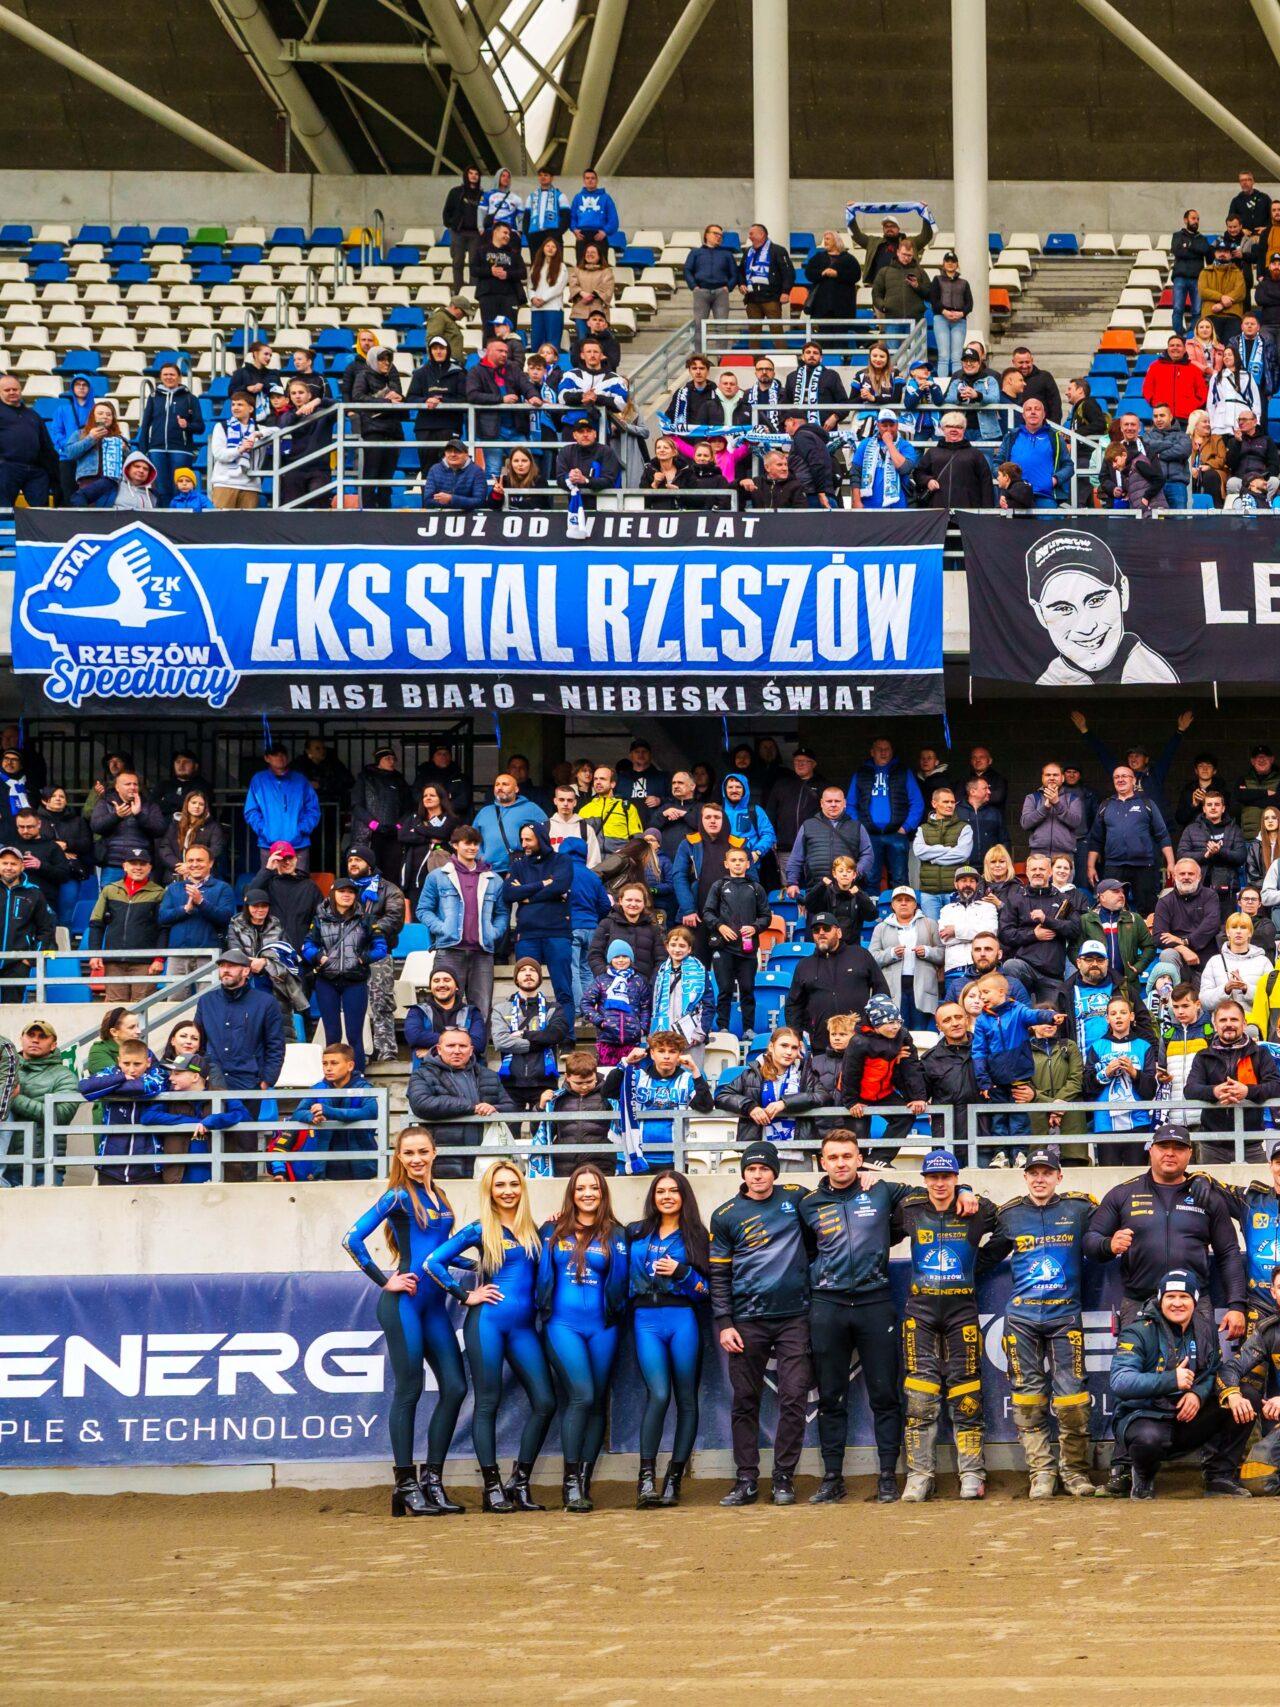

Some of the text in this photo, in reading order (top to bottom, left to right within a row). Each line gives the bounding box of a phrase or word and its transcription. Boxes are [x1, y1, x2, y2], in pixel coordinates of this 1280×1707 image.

[417, 513, 487, 538] JUŻ
[502, 516, 549, 538] OD
[696, 516, 761, 539] LAT
[54, 541, 101, 593] STAL
[151, 576, 181, 592] ZK
[158, 592, 172, 607] S
[246, 553, 917, 663] ZKS STAL RZESZÓW
[78, 642, 210, 666] RZESZÓW
[49, 661, 237, 706] Speedway
[290, 683, 388, 710] NASZ
[402, 682, 516, 709] BIAŁO
[560, 685, 746, 711] NIEBIESKI
[762, 680, 875, 711] ŚWIAT
[1034, 1233, 1074, 1244] rzeszów
[923, 1249, 936, 1263] STAL
[0, 1331, 440, 1398] ENERG
[79, 1420, 103, 1442] &
[118, 1414, 378, 1442] TECHNOLOGY
